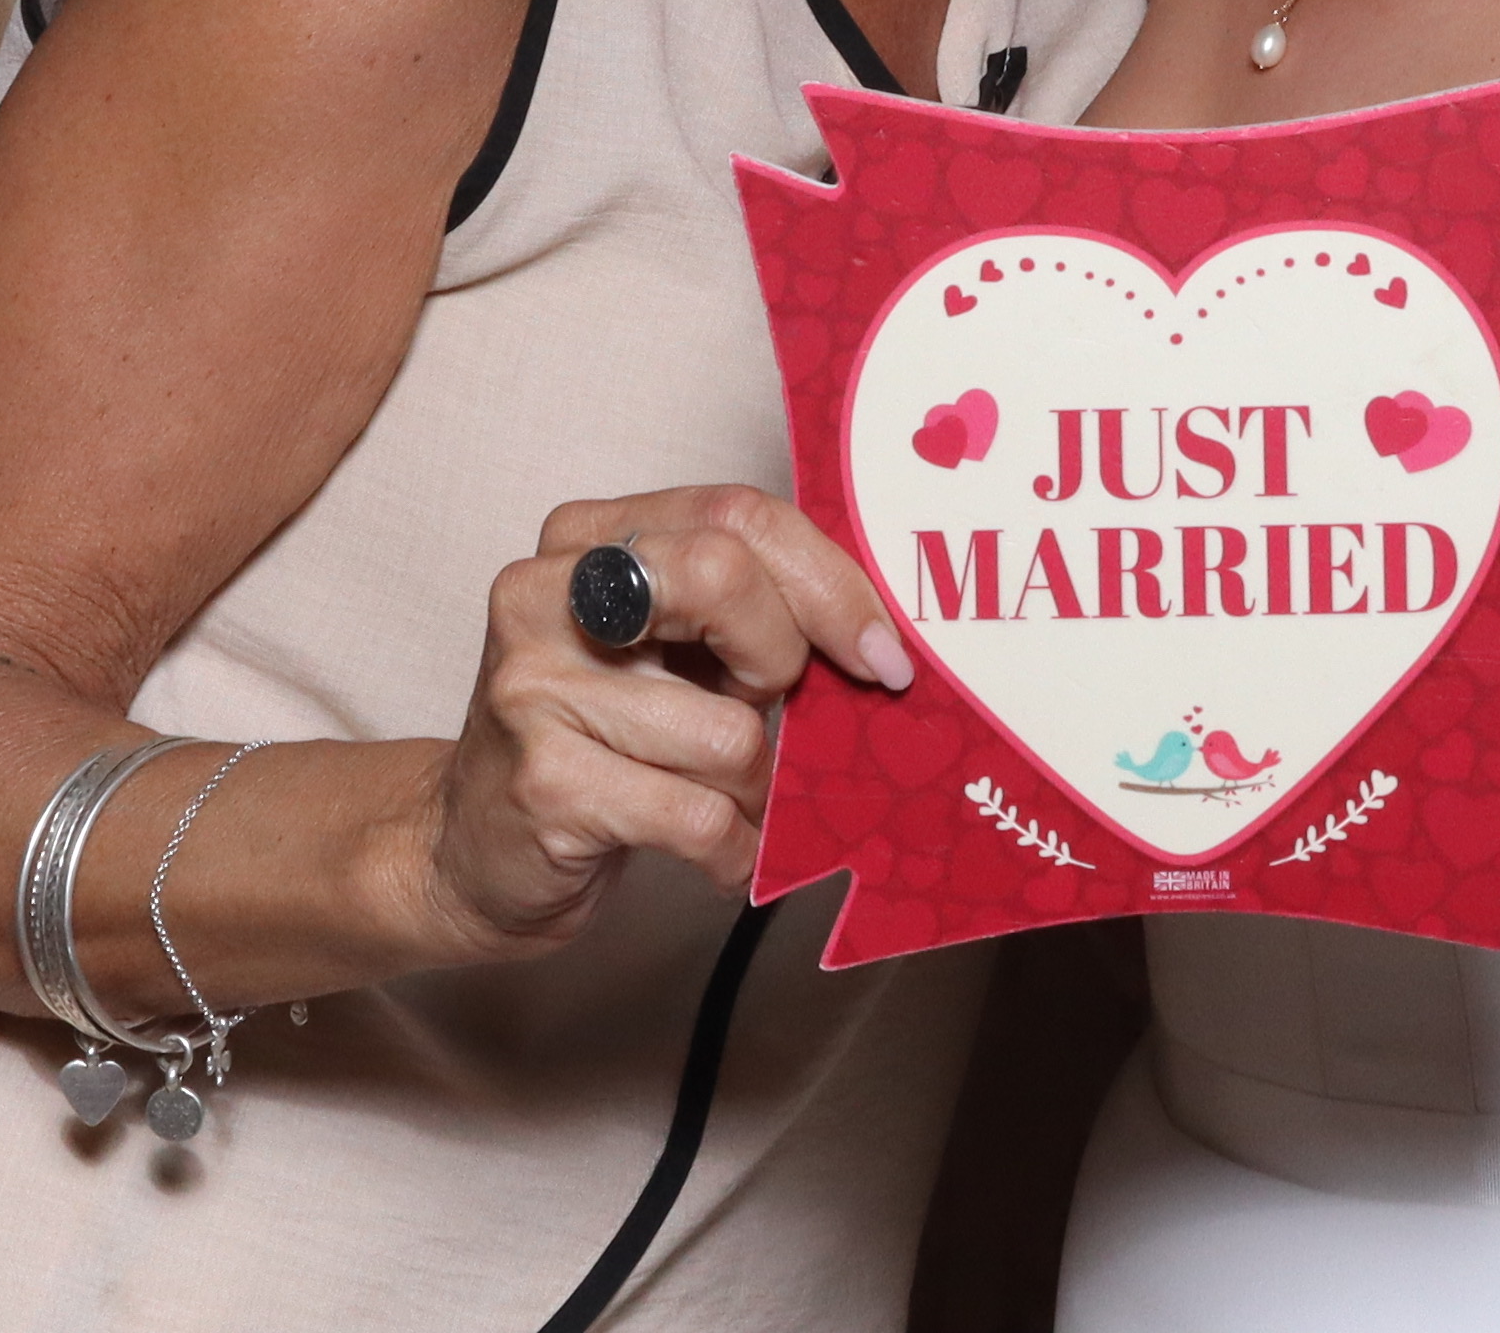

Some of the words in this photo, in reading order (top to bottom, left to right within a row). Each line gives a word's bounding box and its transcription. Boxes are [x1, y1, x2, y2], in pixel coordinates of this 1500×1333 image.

[1032, 404, 1312, 502] JUST
[910, 522, 1460, 623] MARRIED
[1186, 870, 1215, 880] MADE
[1219, 870, 1230, 880] IN
[1186, 880, 1230, 890] BRITAIN
